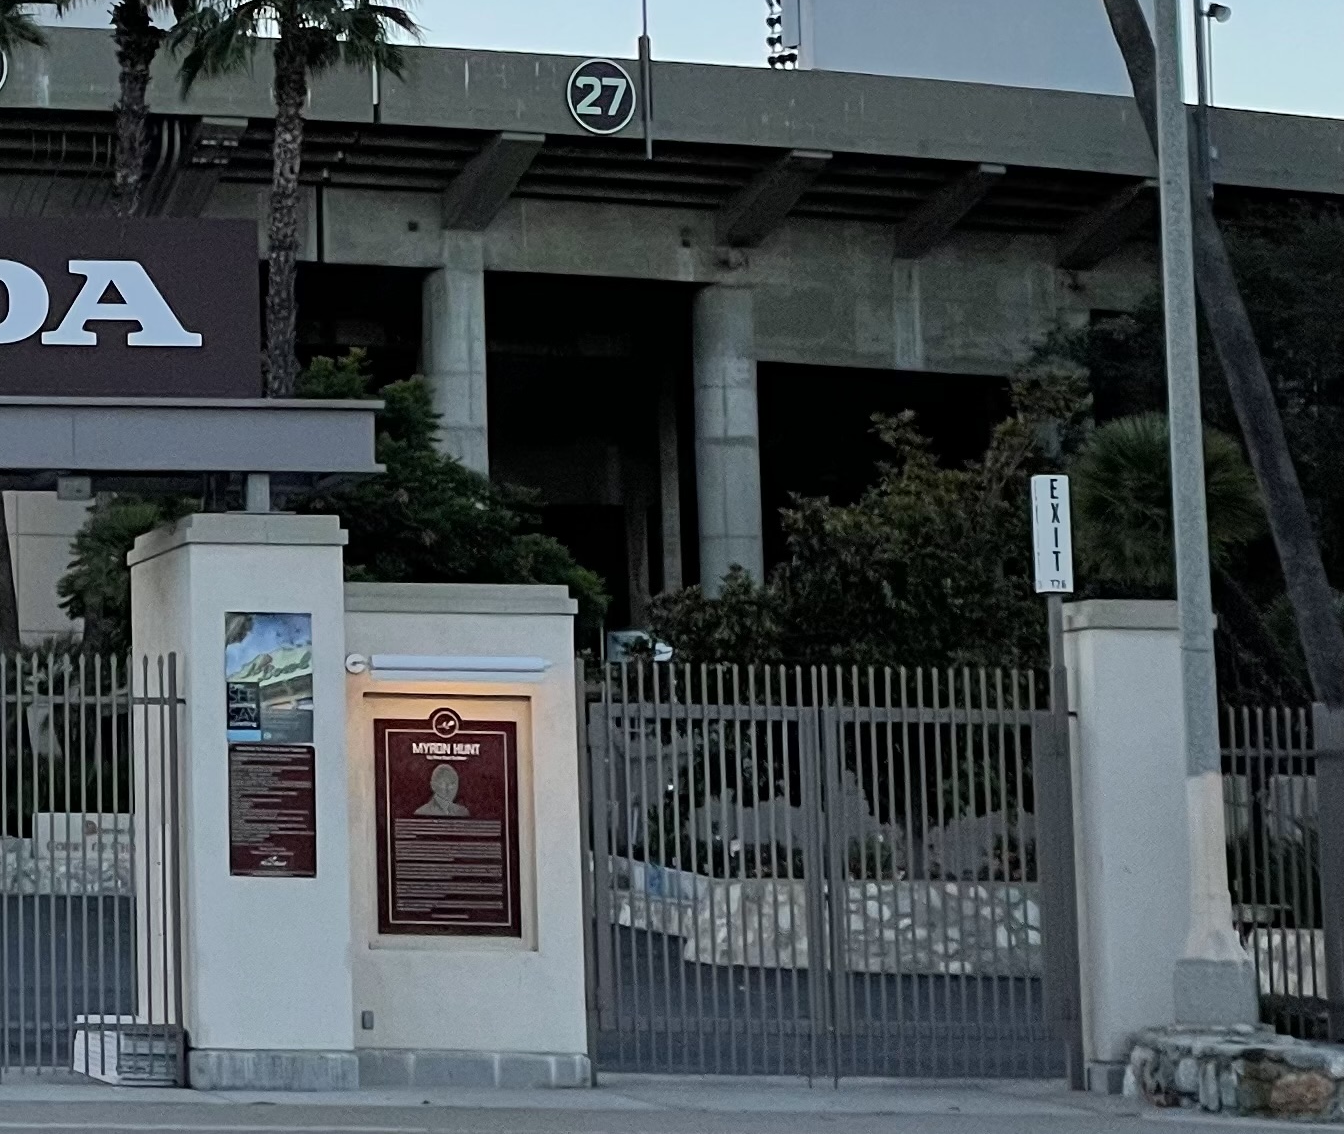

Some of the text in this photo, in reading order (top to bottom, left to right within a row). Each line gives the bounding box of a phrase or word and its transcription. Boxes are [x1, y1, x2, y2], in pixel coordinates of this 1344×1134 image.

[575, 76, 627, 116] 27
[1050, 479, 1061, 572] EXIT
[412, 742, 481, 756] MYRON HUNT
